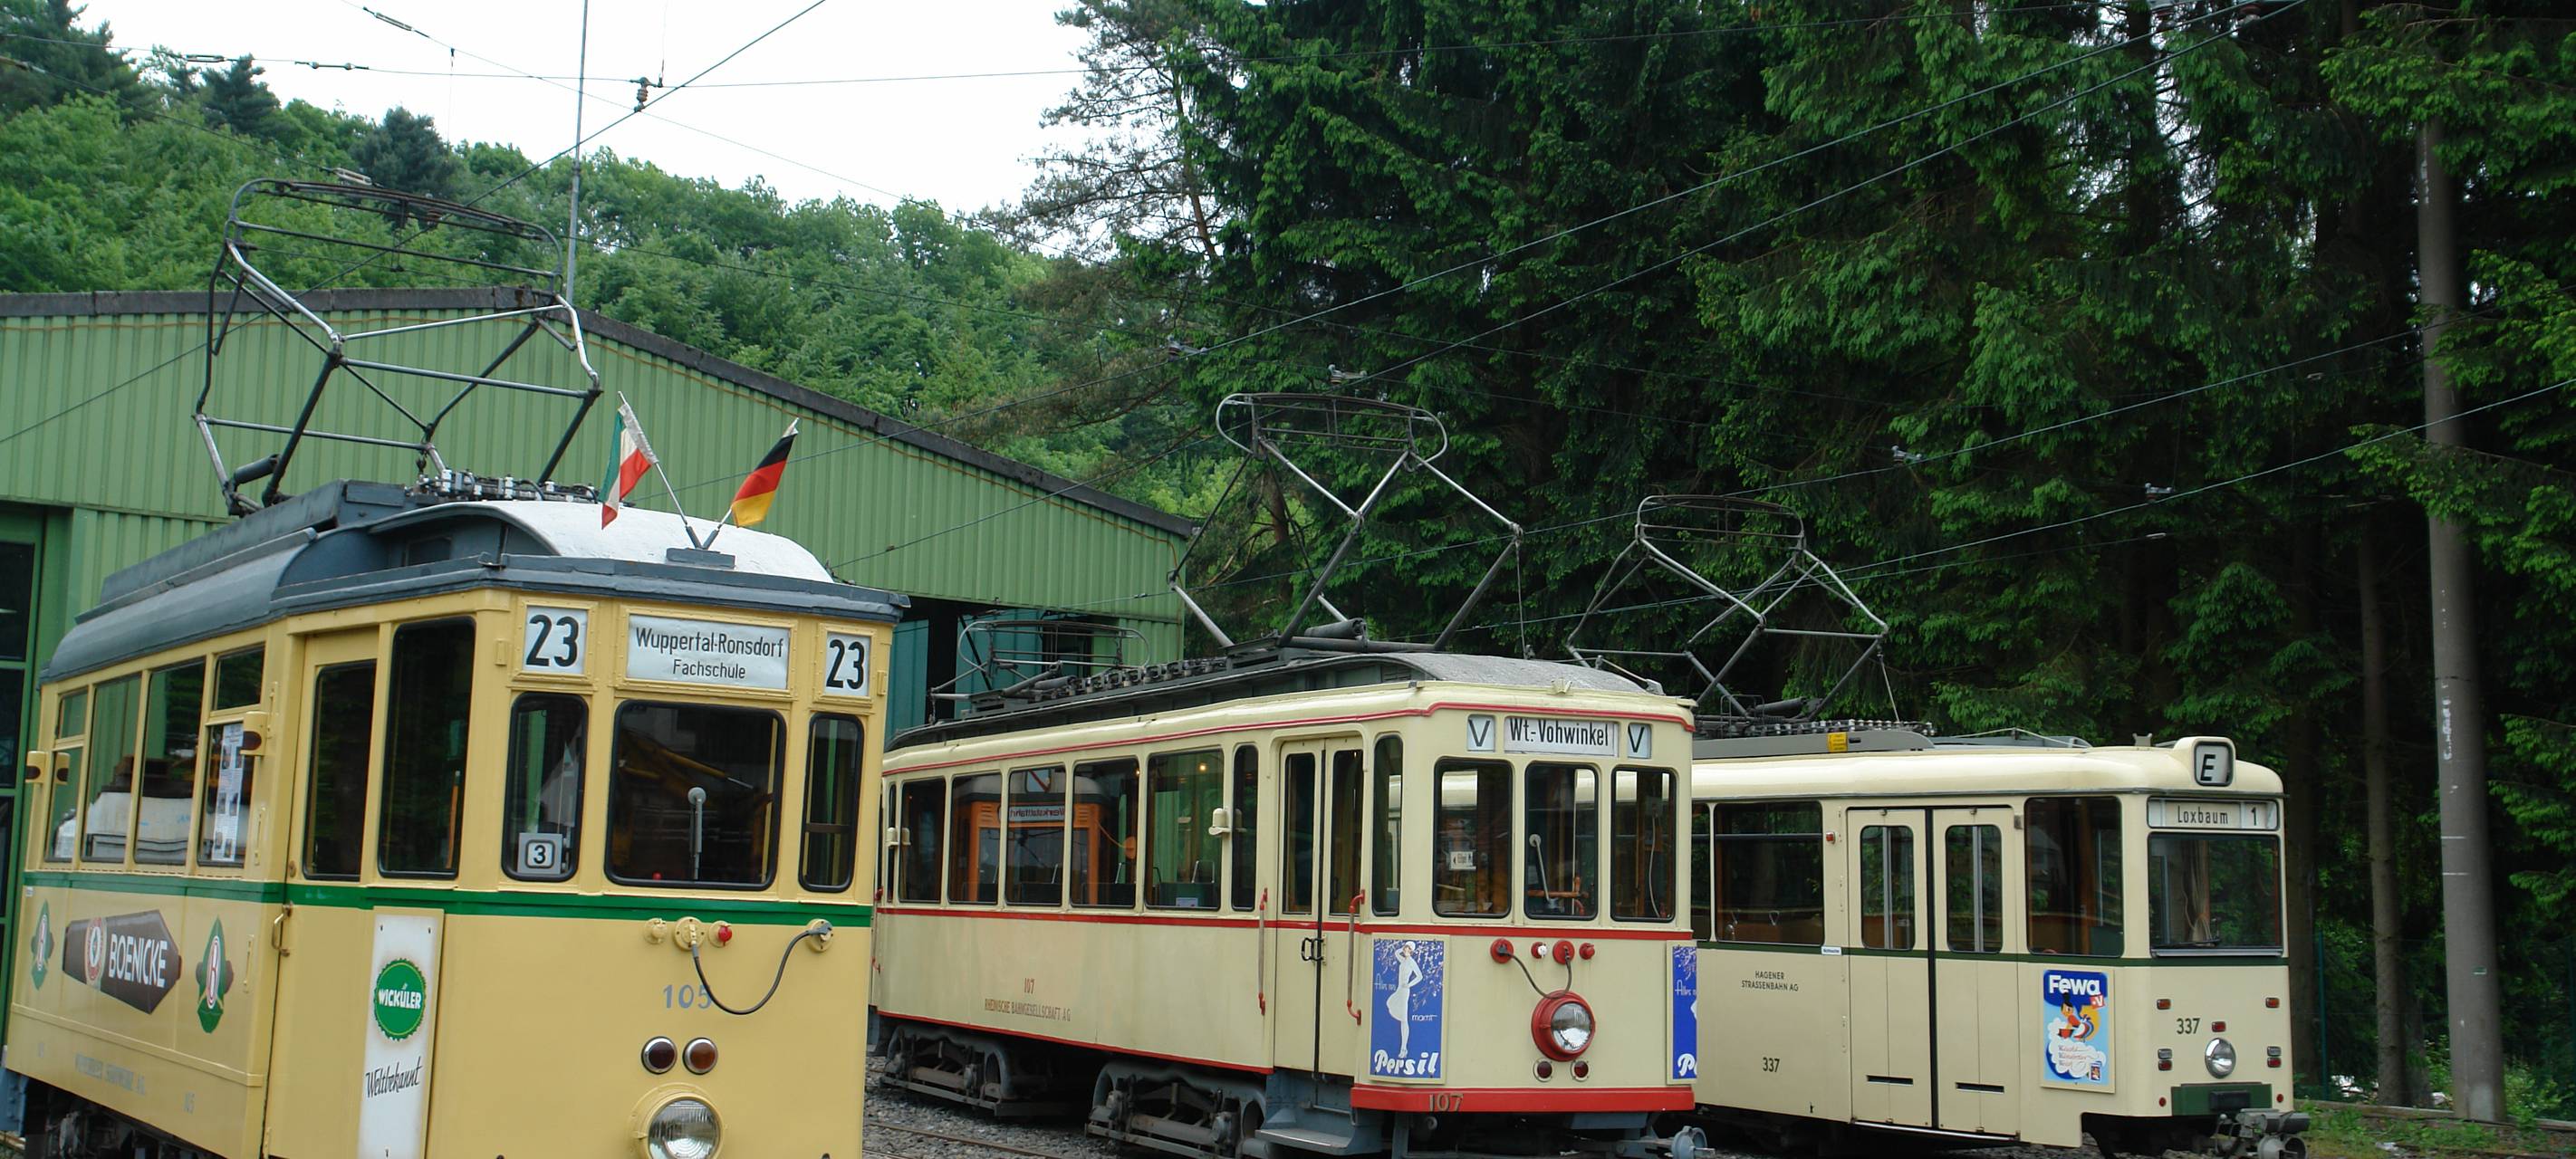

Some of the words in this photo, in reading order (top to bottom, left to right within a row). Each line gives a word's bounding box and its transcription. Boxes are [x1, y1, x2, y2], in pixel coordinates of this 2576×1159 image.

[524, 614, 580, 667] 23
[636, 627, 784, 657] Wuppertal-Ronsdorf
[672, 658, 746, 680] Fachschule
[825, 638, 865, 690] 23
[1467, 719, 1491, 747] V
[1628, 724, 1645, 753] V
[2200, 753, 2216, 781] E
[2177, 805, 2229, 825] Loxbaum
[2251, 806, 2257, 827] 1
[533, 844, 547, 865] 3
[108, 934, 168, 988] BOENICKE
[1741, 980, 1788, 991] STRASSENBAHN
[1789, 982, 1799, 992] AG
[1754, 970, 1784, 981] HAGENER
[2049, 974, 2101, 996] Fewa
[378, 983, 422, 1010] WICKÜLER
[663, 984, 713, 1010] 105
[2176, 1017, 2201, 1035] 337
[1374, 1049, 1439, 1076] Persil
[1762, 1057, 1780, 1073] 337
[365, 1056, 423, 1099] Weltbekannt
[1429, 1092, 1465, 1112] 107
